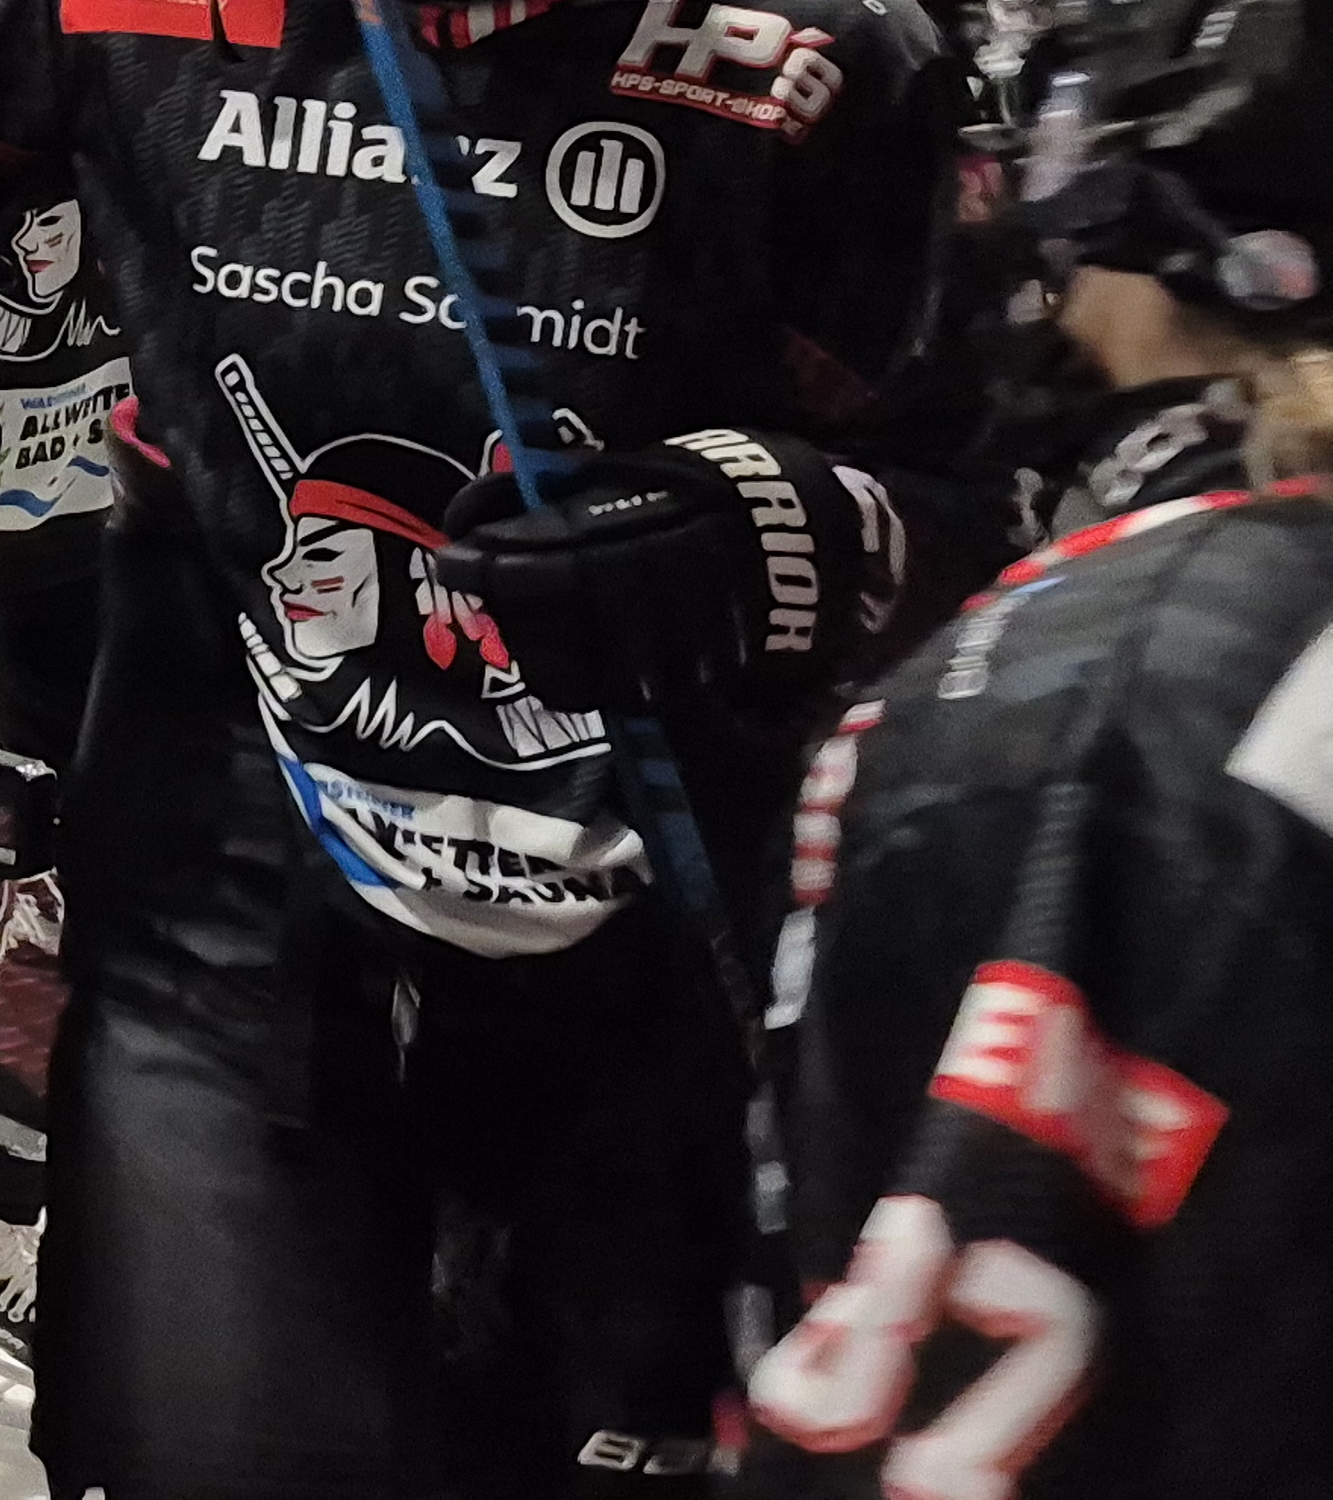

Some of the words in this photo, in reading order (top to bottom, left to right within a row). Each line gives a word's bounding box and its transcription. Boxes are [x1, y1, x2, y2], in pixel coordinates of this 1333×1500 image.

[197, 89, 523, 199] Alliaz
[190, 245, 385, 317] Sascha
[399, 274, 648, 360] Scmidt
